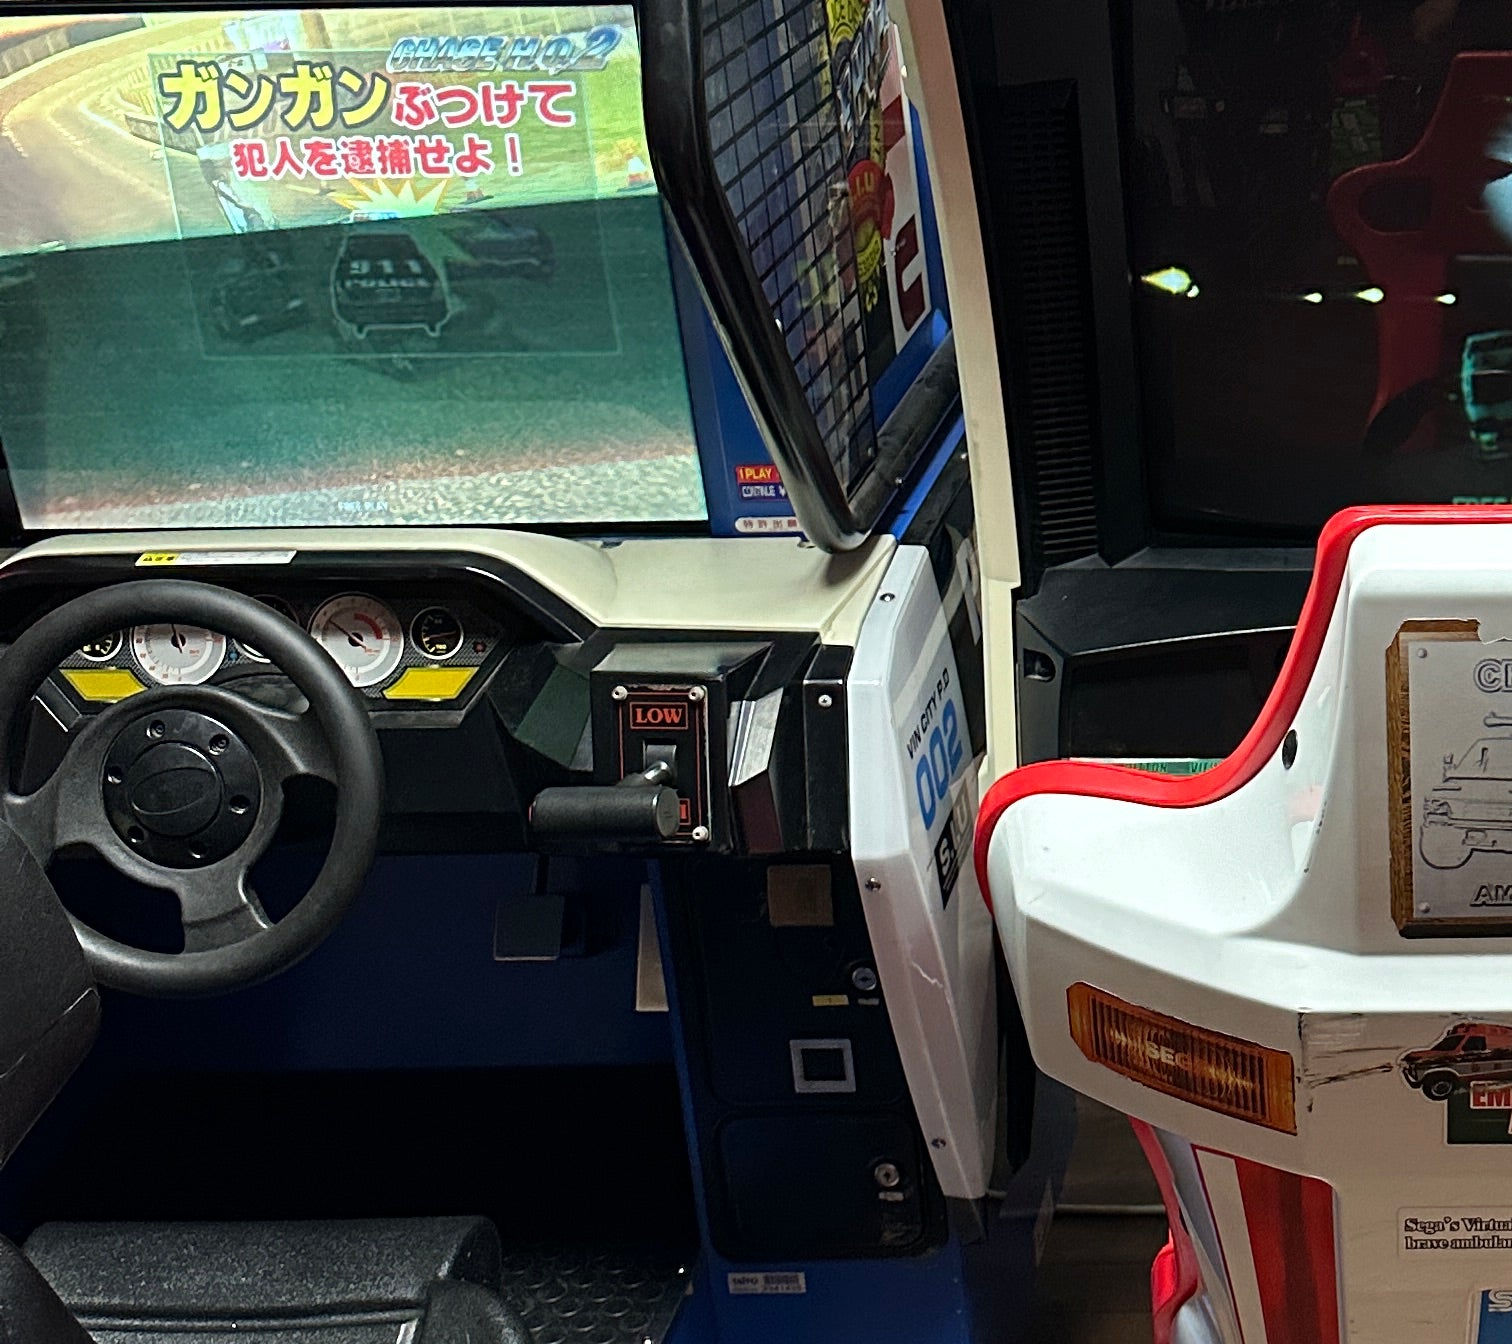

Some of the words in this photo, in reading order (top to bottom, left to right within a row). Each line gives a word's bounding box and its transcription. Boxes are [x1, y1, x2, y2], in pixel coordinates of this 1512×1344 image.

[635, 707, 682, 723] LOW
[1404, 1217, 1460, 1234] Sega's
[1405, 1236, 1448, 1249] brave
